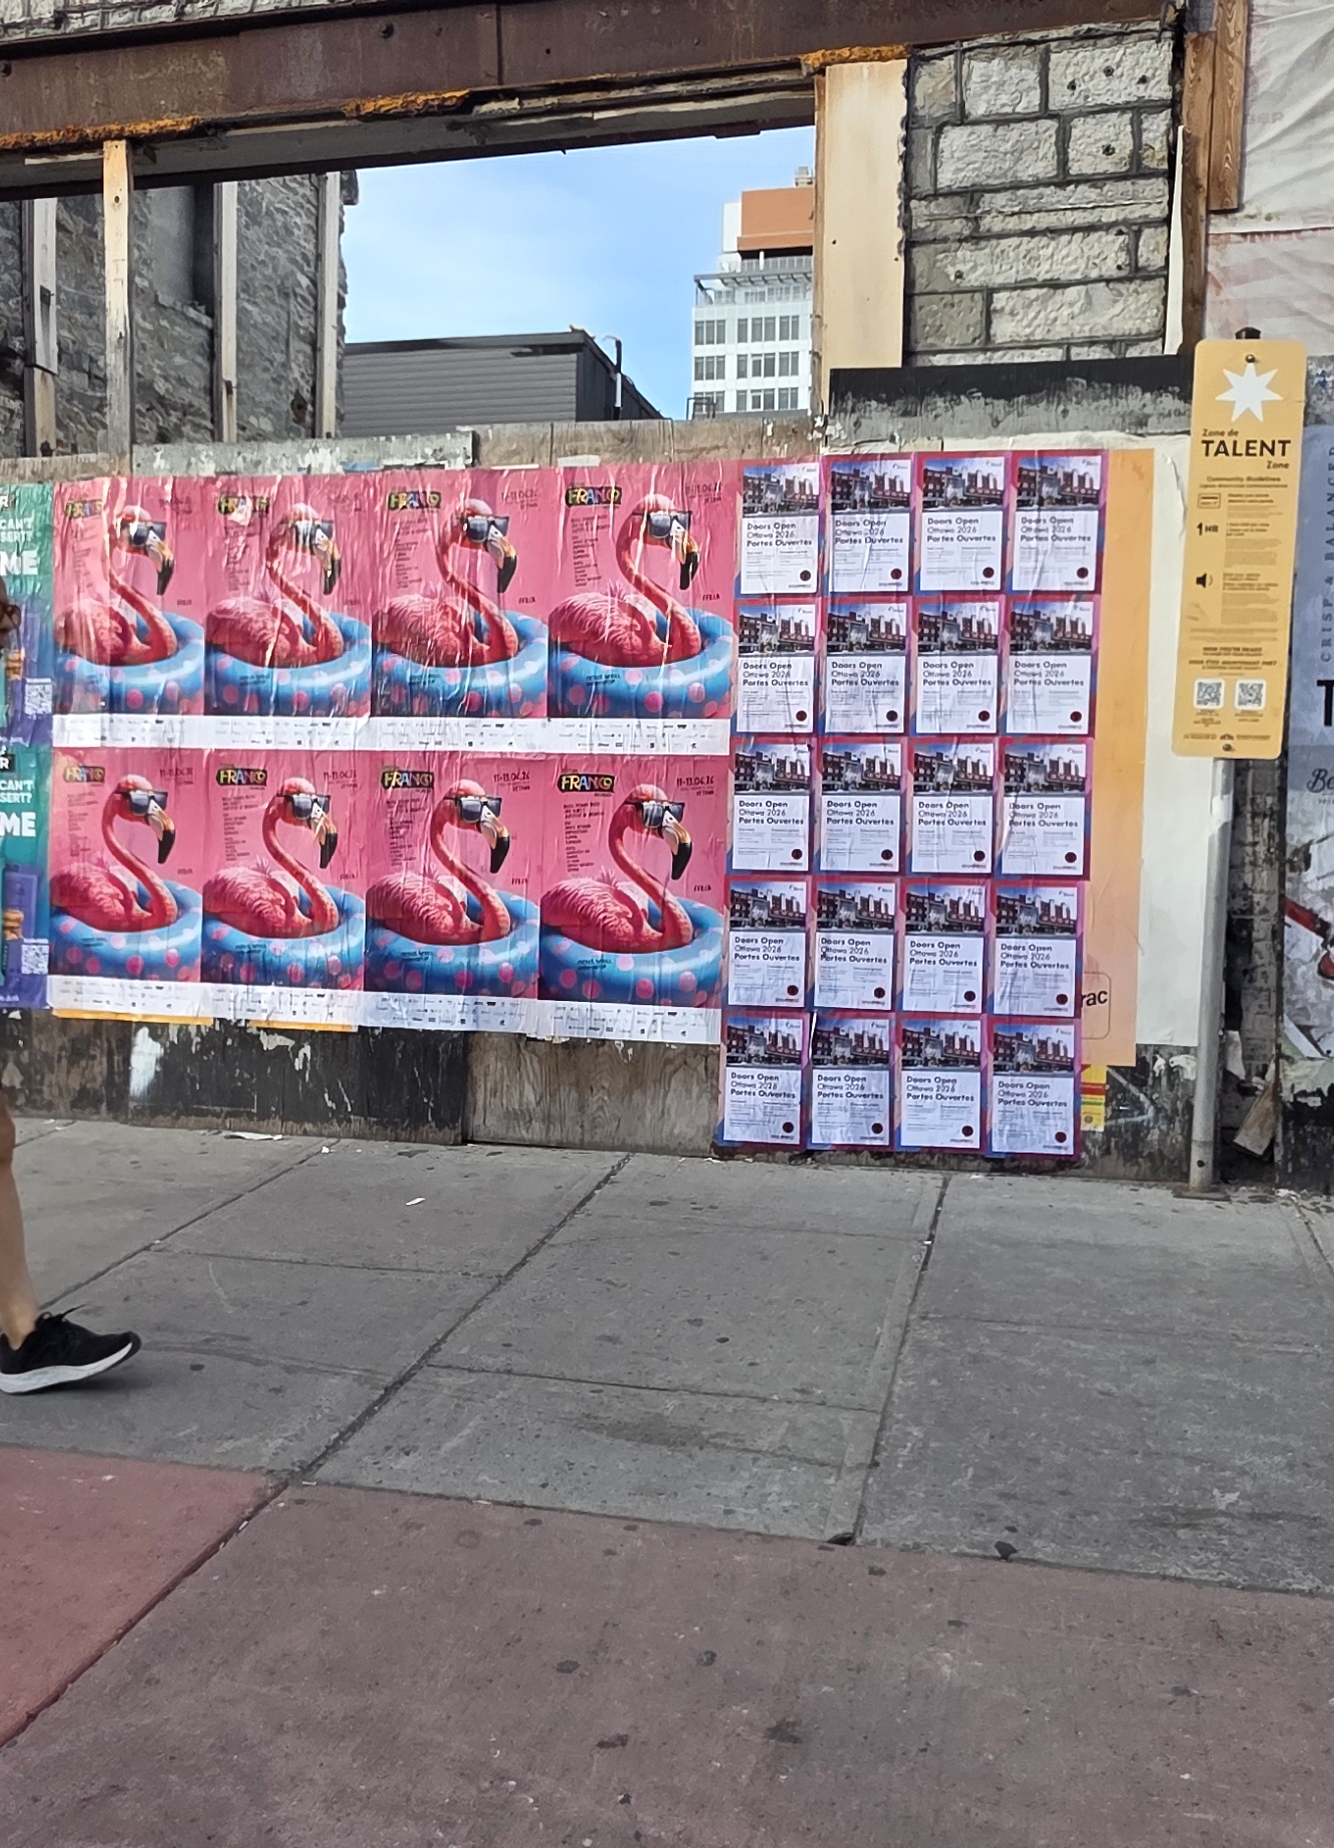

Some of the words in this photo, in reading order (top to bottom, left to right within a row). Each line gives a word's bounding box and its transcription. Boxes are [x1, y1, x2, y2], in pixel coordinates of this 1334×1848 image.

[1202, 429, 1225, 437] Zone
[1228, 429, 1239, 437] de
[1201, 440, 1291, 457] TALENT
[1267, 461, 1289, 469] Zone
[0, 518, 35, 530] CAN'T
[774, 522, 796, 532] Open
[955, 517, 979, 527] Open
[927, 526, 955, 534] Ottawa
[1197, 522, 1203, 535] 1
[0, 550, 38, 576] ME
[1320, 599, 1334, 663] CRISP
[859, 661, 882, 672] Open
[219, 769, 267, 786] FRANCO
[384, 771, 433, 788] FRANCO
[0, 779, 34, 792] CAN'T
[561, 775, 614, 792] FRANCO
[765, 801, 788, 811] Open
[767, 817, 804, 825] Ouvertes
[910, 941, 935, 949] Doors
[938, 941, 961, 951] Open
[910, 958, 936, 966] Portes
[939, 959, 977, 967] Ouvertes
[844, 1075, 866, 1085] Open
[817, 1083, 843, 1091] Ottawa
